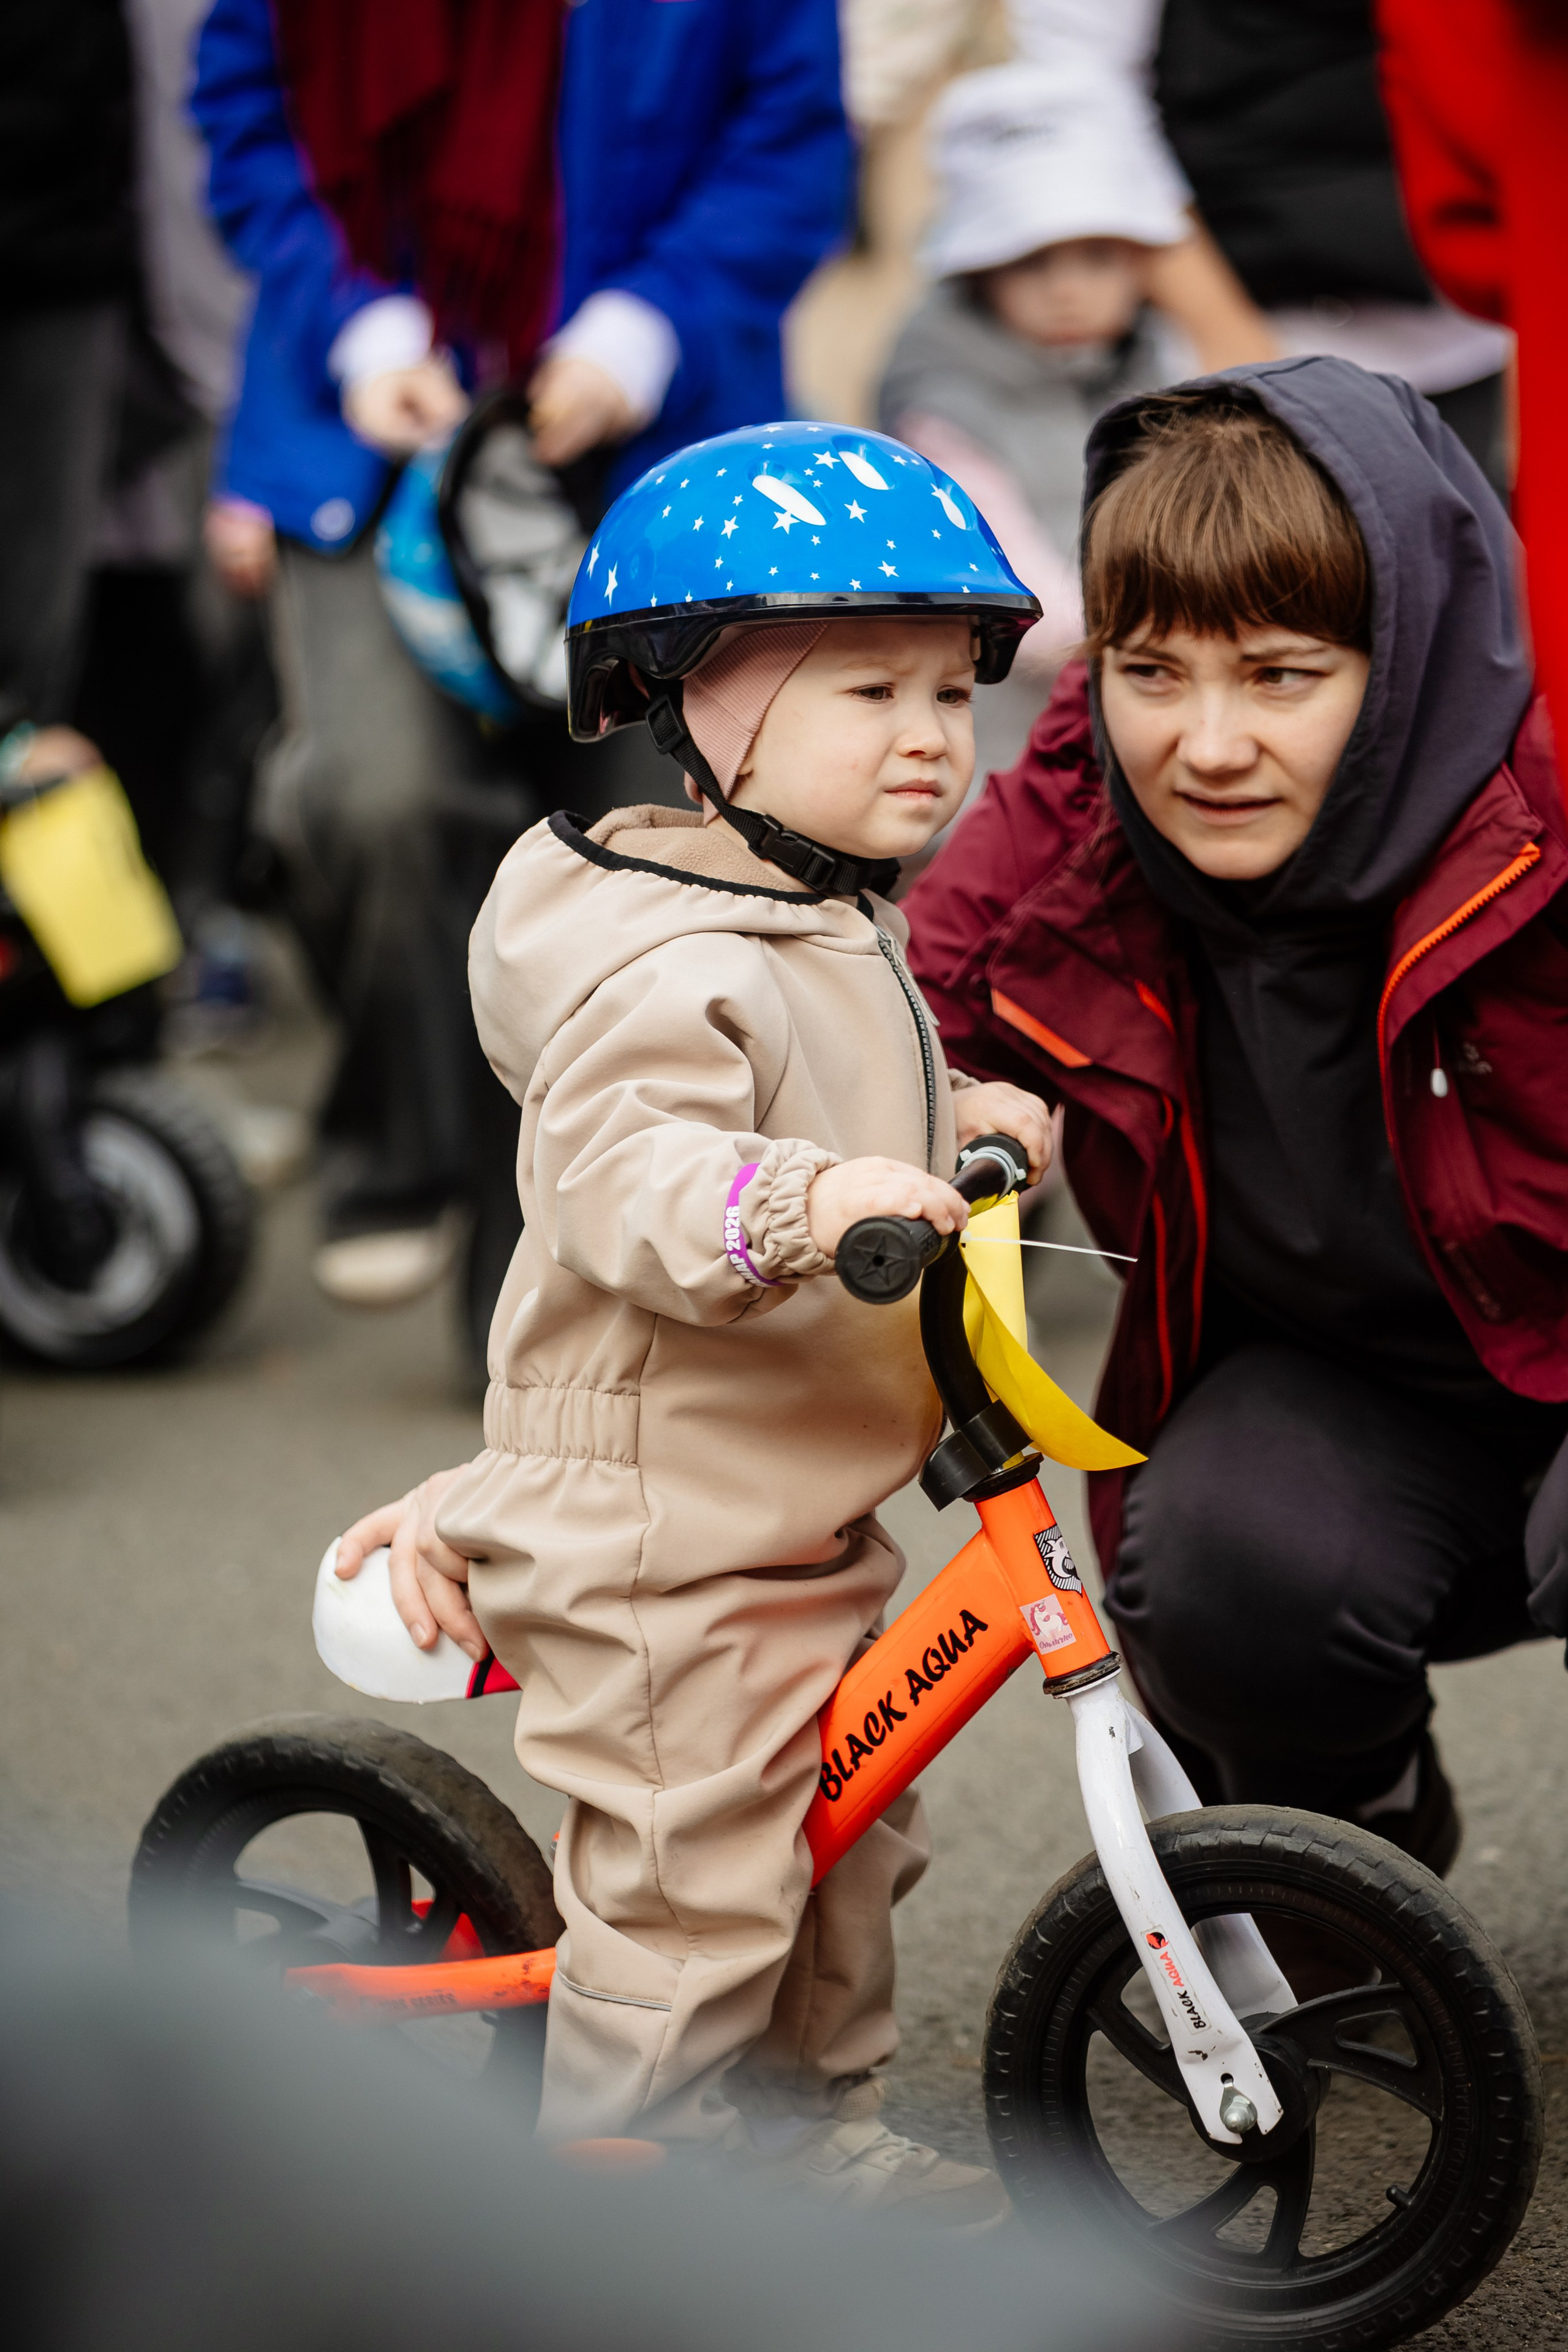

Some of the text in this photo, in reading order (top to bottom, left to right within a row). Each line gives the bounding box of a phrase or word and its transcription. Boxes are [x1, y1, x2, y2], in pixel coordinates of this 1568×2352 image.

[725, 1205, 742, 1252] 2026
[1039, 1632, 1073, 1649] Отлично
[818, 1609, 989, 1802] BLACK AQUA
[1159, 1951, 1207, 2030] BLACK AQUA
